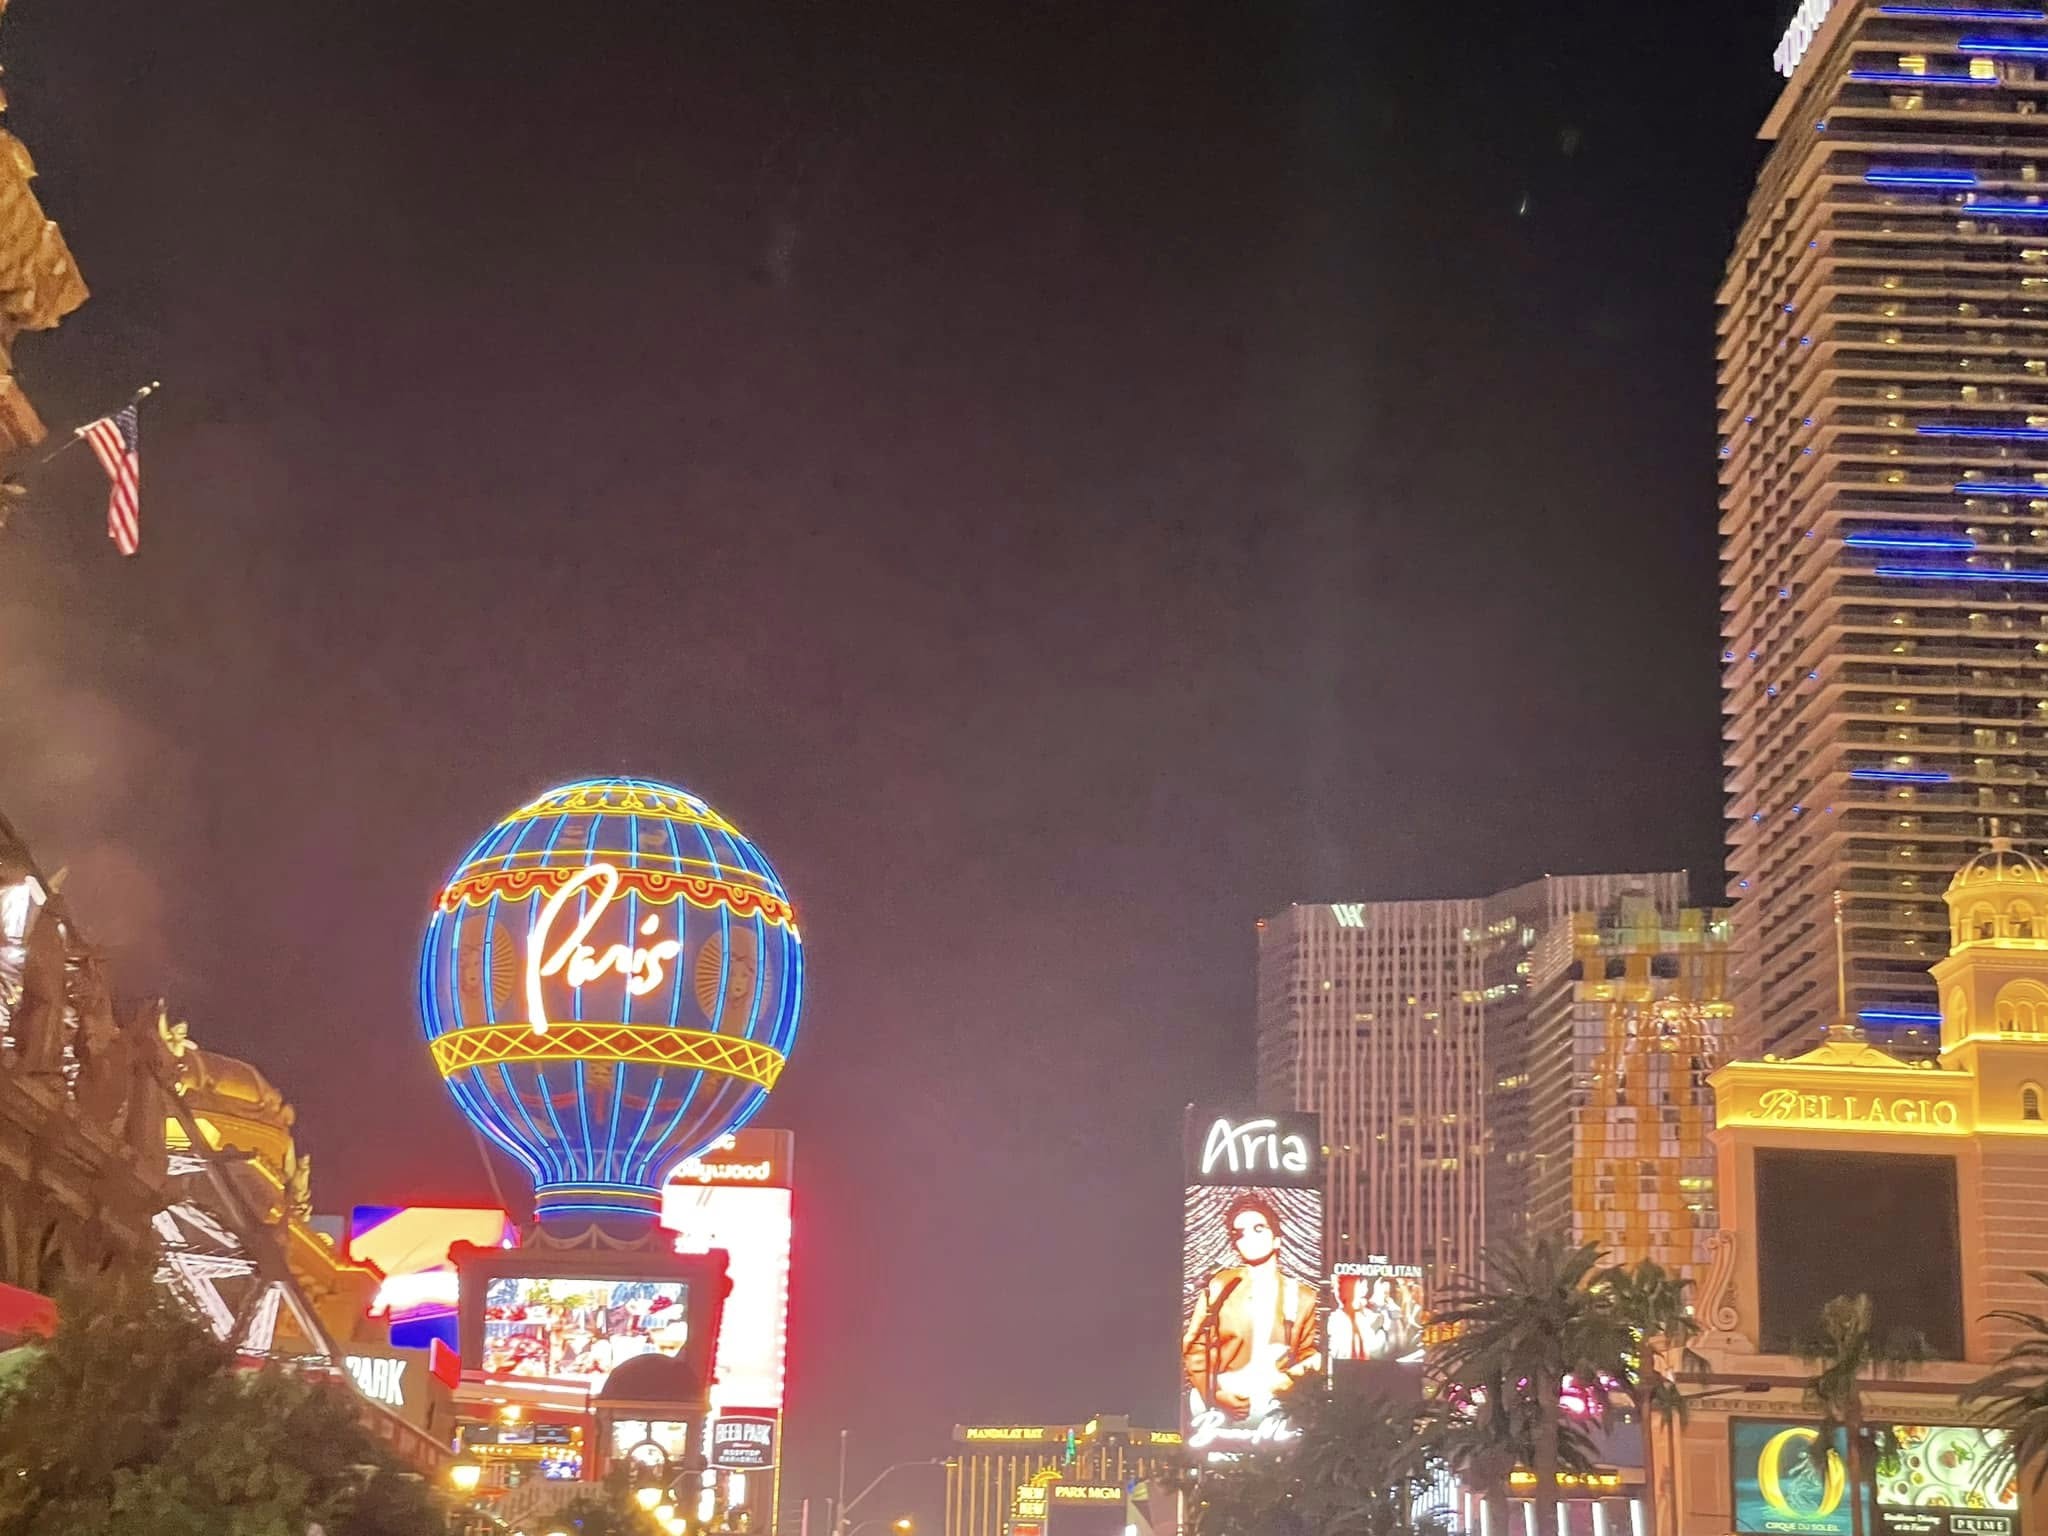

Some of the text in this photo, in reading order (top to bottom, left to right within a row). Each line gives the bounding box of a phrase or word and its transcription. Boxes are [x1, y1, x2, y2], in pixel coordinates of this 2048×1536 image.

[526, 863, 683, 1035] Paris
[1747, 1088, 1958, 1126] BELLAGIO
[1202, 1118, 1308, 1173] Aria
[671, 1156, 771, 1184] ollywood
[1333, 1263, 1422, 1277] COSMOPOLITAN
[1055, 1486, 1121, 1500] PARK MGM
[1956, 1519, 2004, 1531] PRIME
